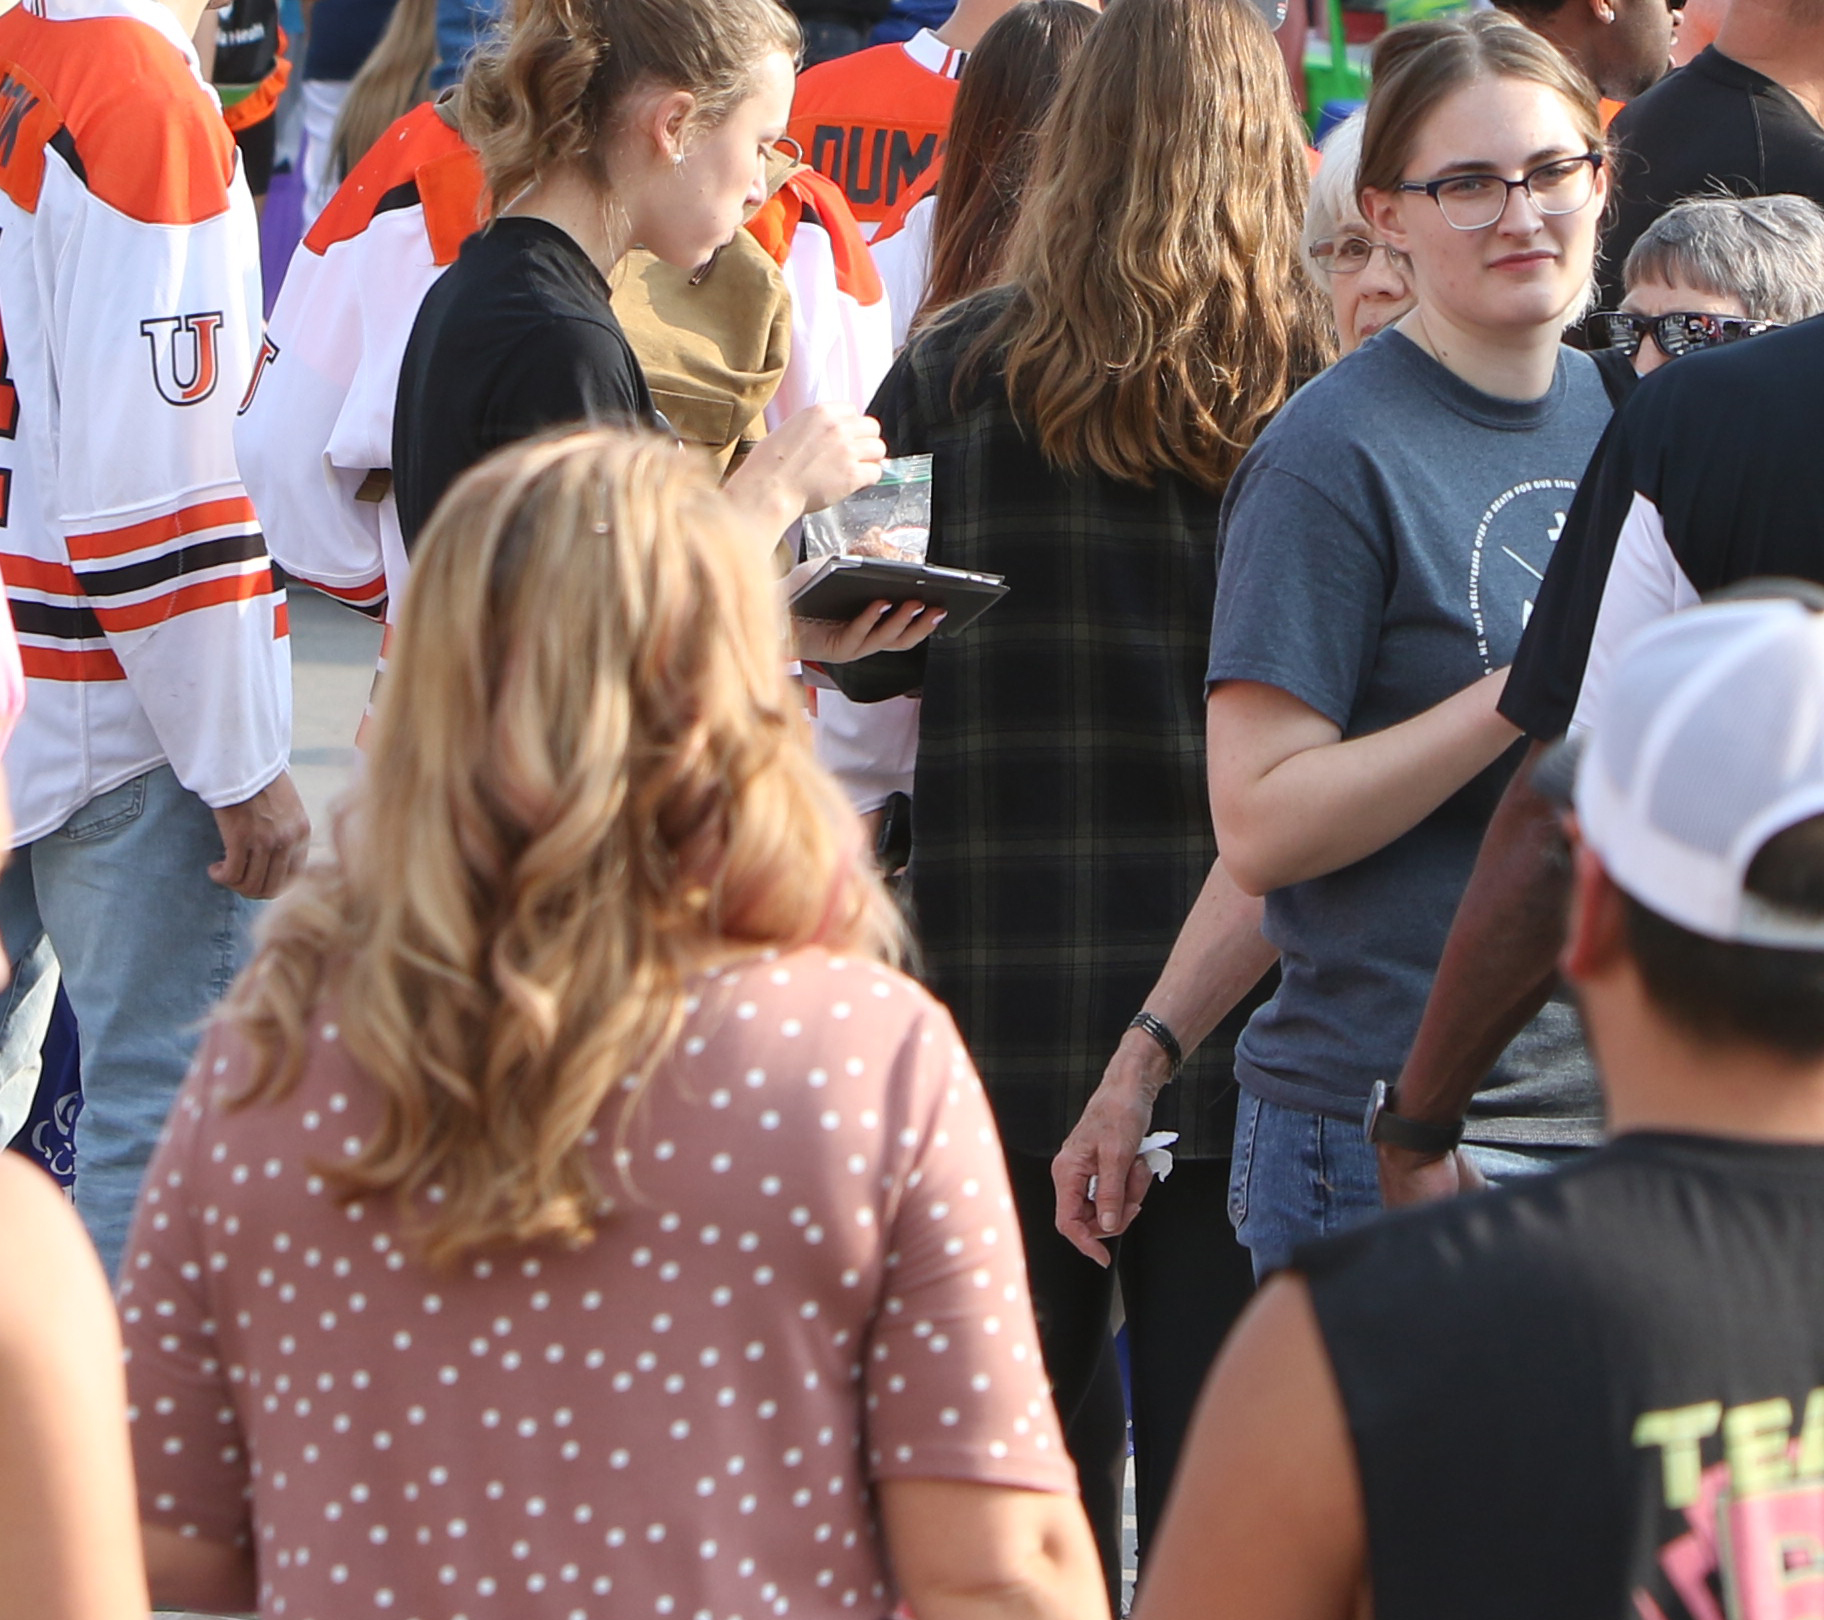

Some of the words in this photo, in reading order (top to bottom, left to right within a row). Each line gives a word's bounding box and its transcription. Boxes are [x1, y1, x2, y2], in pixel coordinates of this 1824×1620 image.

[1513, 481, 1533, 496] FOR
[1532, 478, 1553, 490] OUR
[1553, 479, 1577, 491] SINS
[1489, 489, 1515, 514] DEATH
[1482, 511, 1494, 525] TO
[1474, 521, 1488, 549] OVER
[1468, 548, 1481, 610] DELIVERED
[1472, 611, 1485, 637] WAS
